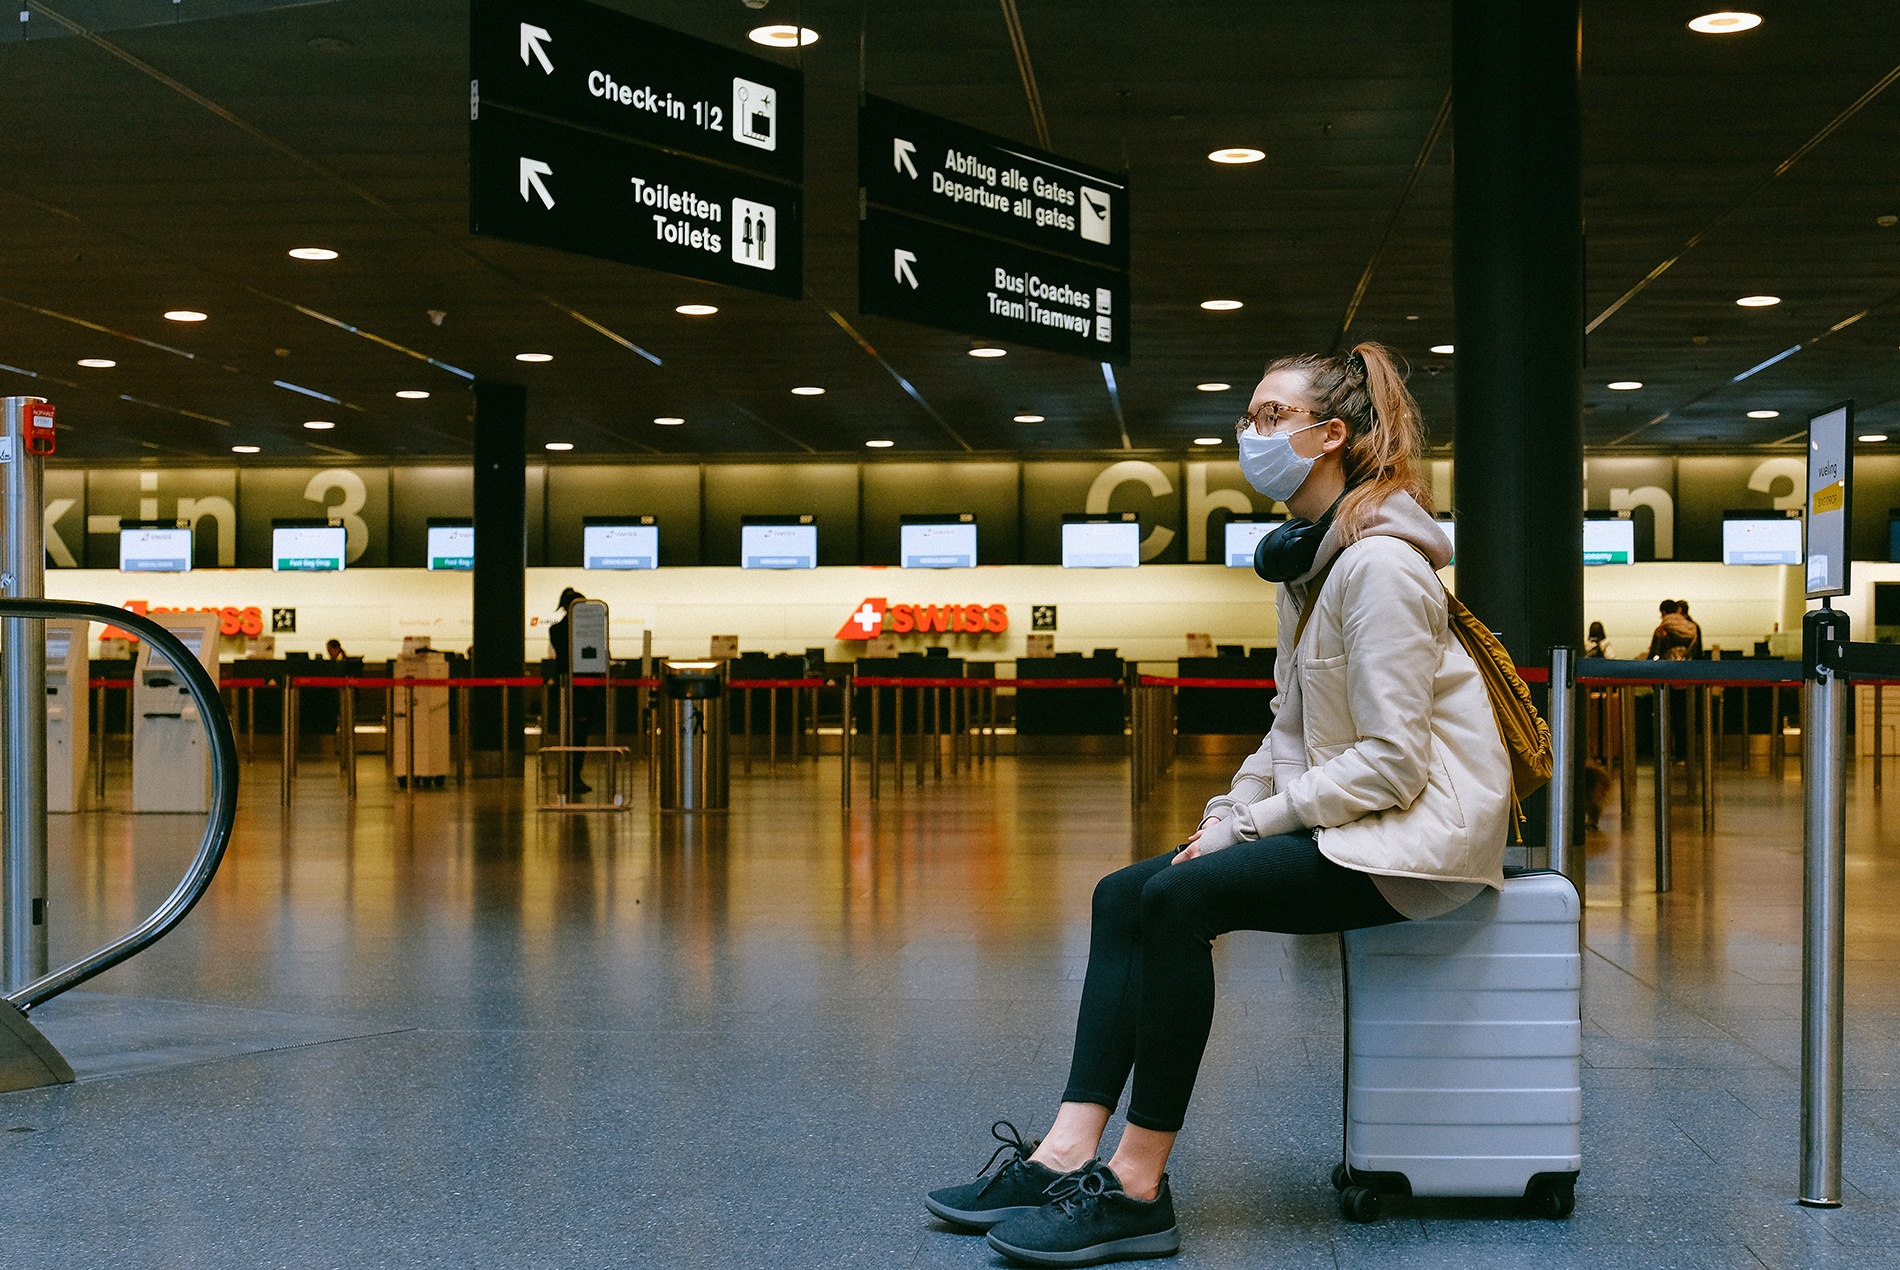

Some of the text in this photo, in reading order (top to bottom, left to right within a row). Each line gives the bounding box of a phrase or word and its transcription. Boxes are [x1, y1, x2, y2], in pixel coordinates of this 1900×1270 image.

[588, 70, 685, 120] Check-in
[631, 177, 722, 222] Toiletten
[945, 149, 1074, 205] Abflug alle Gates
[933, 172, 1075, 231] Departure all gates
[653, 215, 722, 253] Toilets
[1818, 459, 1838, 478] vueling
[304, 469, 369, 565] 3
[891, 604, 1009, 634] SWISS
